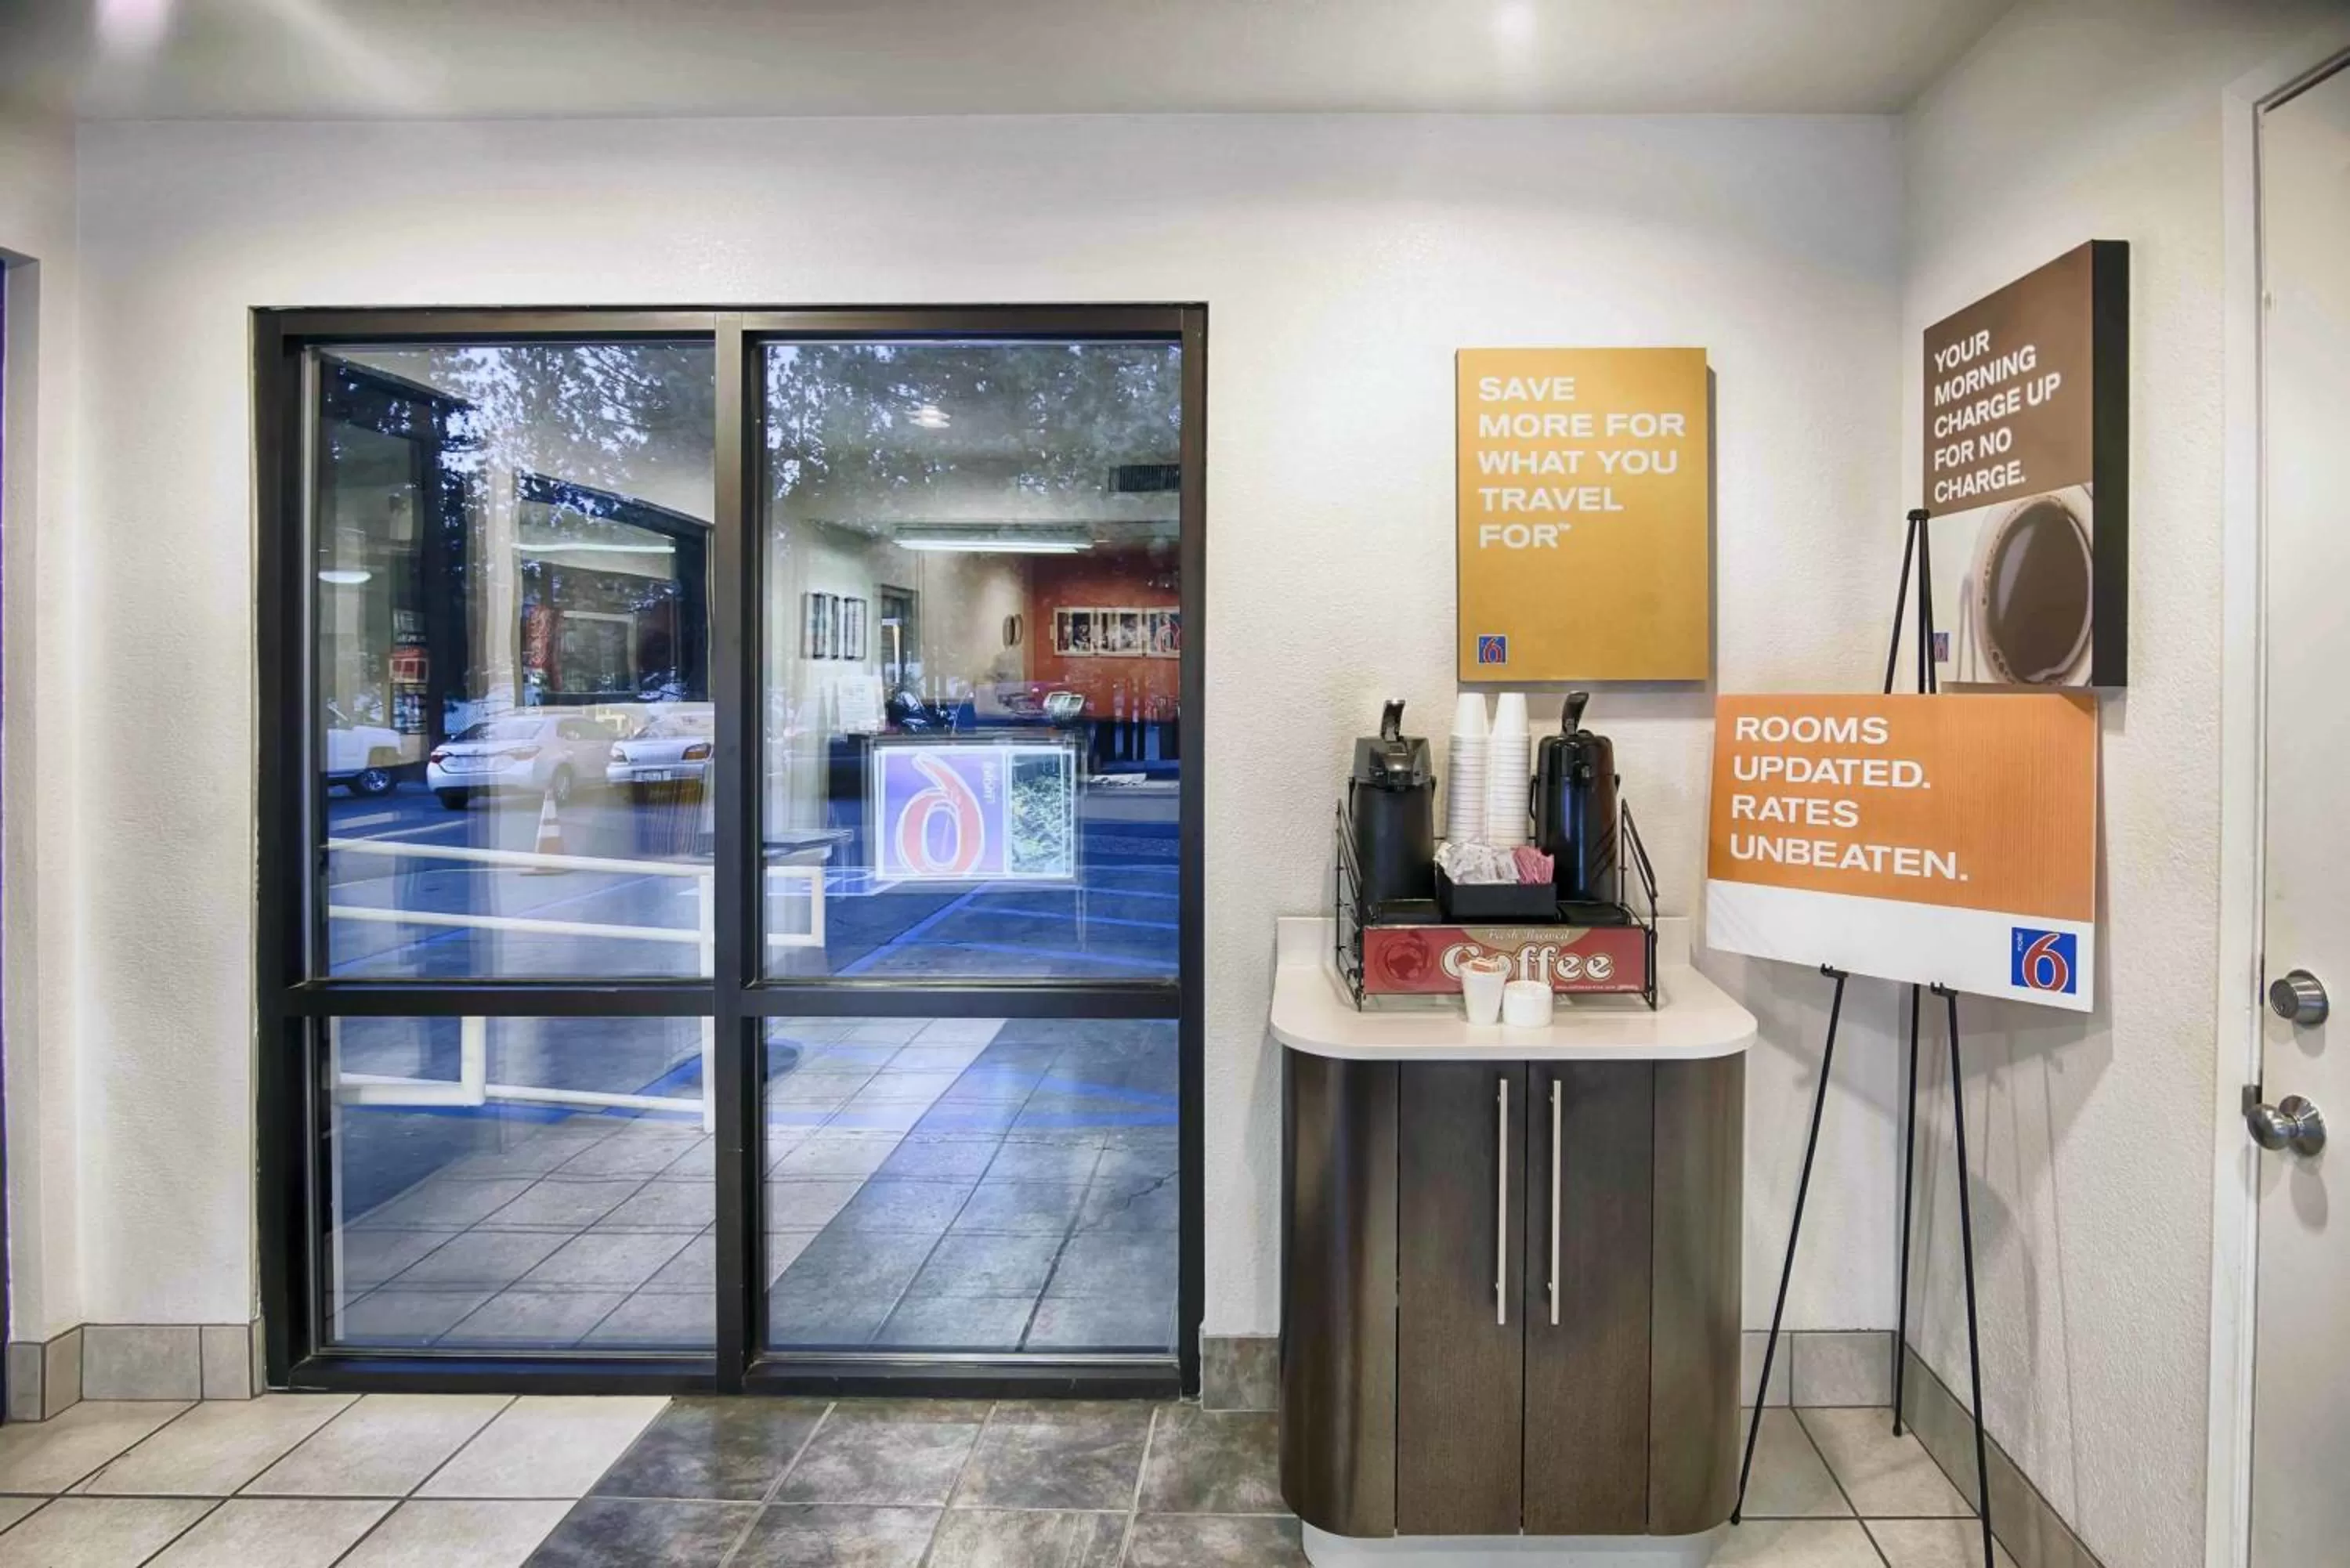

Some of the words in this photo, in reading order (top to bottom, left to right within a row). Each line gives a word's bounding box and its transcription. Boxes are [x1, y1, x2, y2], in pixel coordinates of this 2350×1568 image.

[1934, 329, 1990, 374] YOUR
[1478, 376, 1576, 402] SAVE
[1934, 345, 2037, 407] MORNING
[1934, 387, 2021, 439] CHARGE
[2026, 372, 2062, 406] UP
[1478, 413, 1595, 438] MORE
[1605, 413, 1686, 438] FOR
[1477, 450, 1585, 475] WHAT
[1596, 450, 1678, 475] YOU
[1934, 443, 1975, 471] FOR
[1979, 426, 2012, 458] NO
[1478, 486, 1624, 511] TRAVEL
[1934, 460, 2026, 504] CHARGE.
[1735, 716, 1889, 745] ROOMS
[1733, 756, 1931, 789] UPDATED.
[1731, 794, 1859, 828] RATES
[1730, 833, 1969, 881] UNBEATEN.
[2022, 933, 2069, 993] 6
